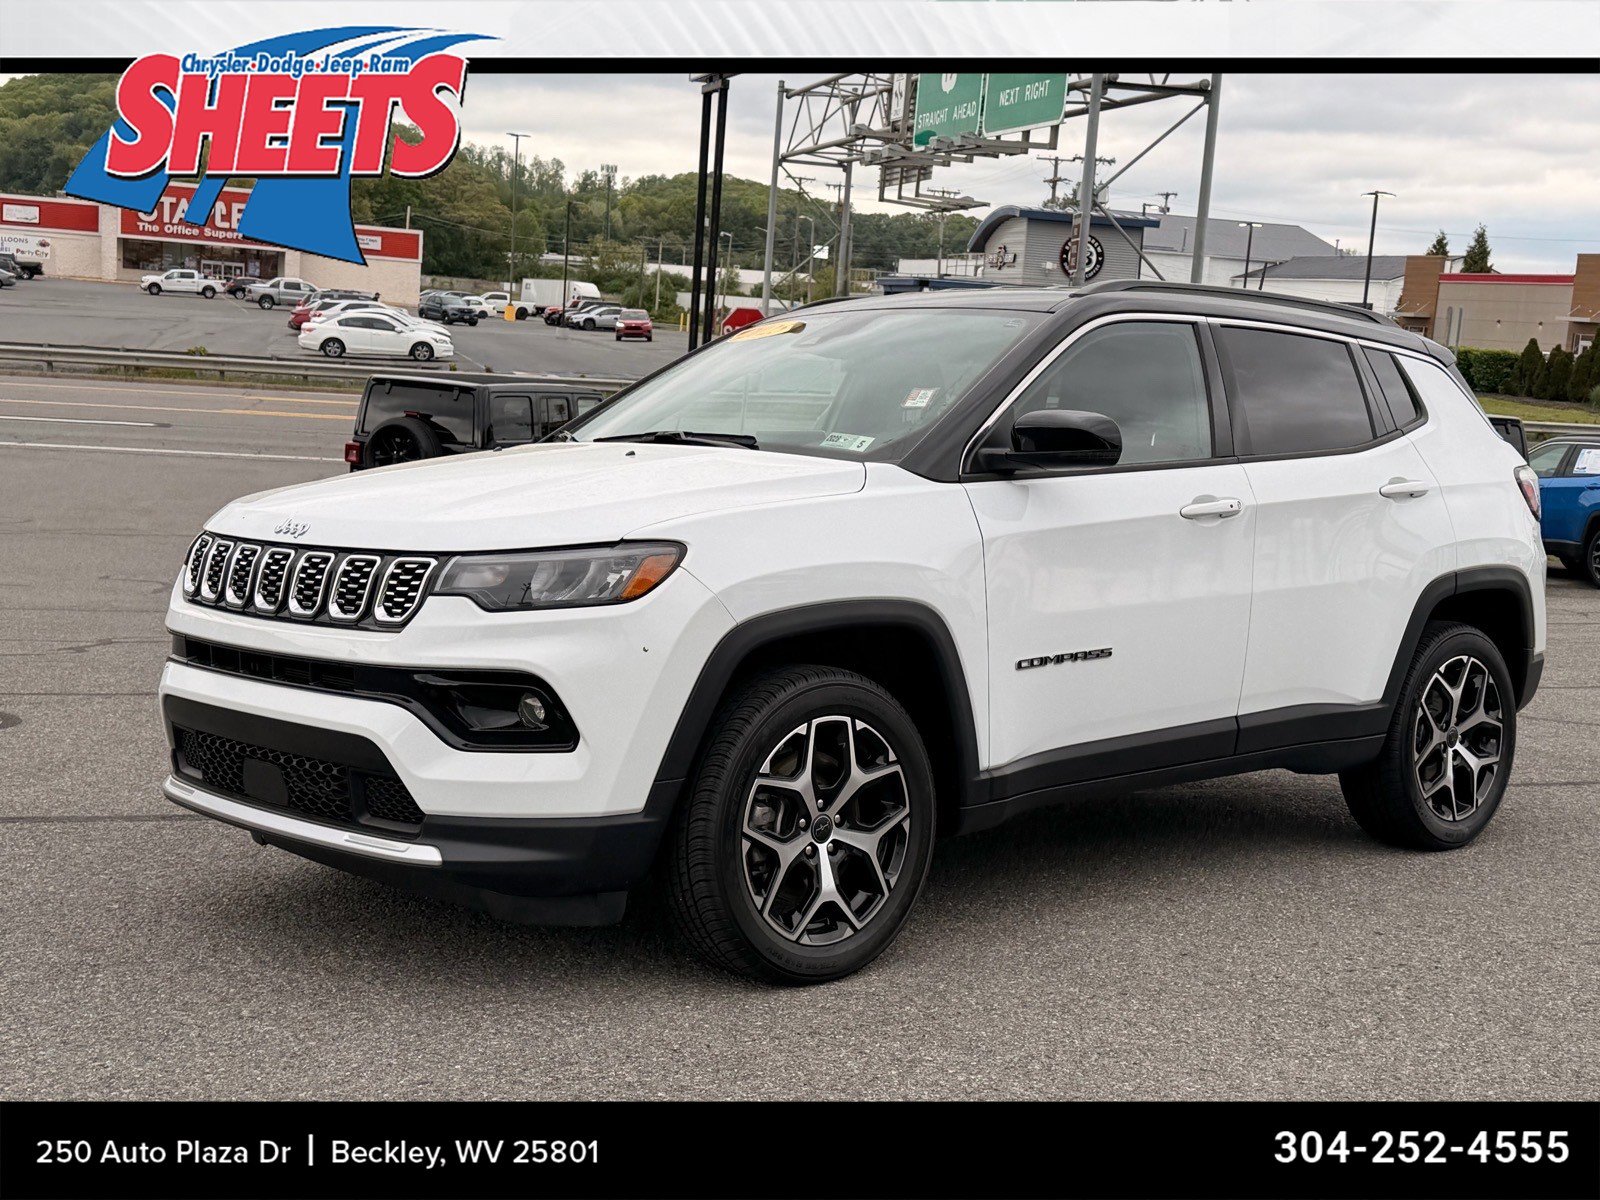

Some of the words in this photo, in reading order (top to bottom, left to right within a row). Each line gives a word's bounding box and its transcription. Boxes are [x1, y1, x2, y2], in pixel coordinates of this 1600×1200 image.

[999, 86, 1020, 106] NEXT
[1024, 79, 1051, 102] RIGHT
[918, 108, 949, 129] STRAIGHT
[952, 101, 977, 121] AHEAD
[137, 222, 160, 233] The
[164, 223, 200, 237] Office
[856, 440, 867, 449] 5
[274, 518, 311, 539] Jeep
[1015, 647, 1113, 671] COMPASS
